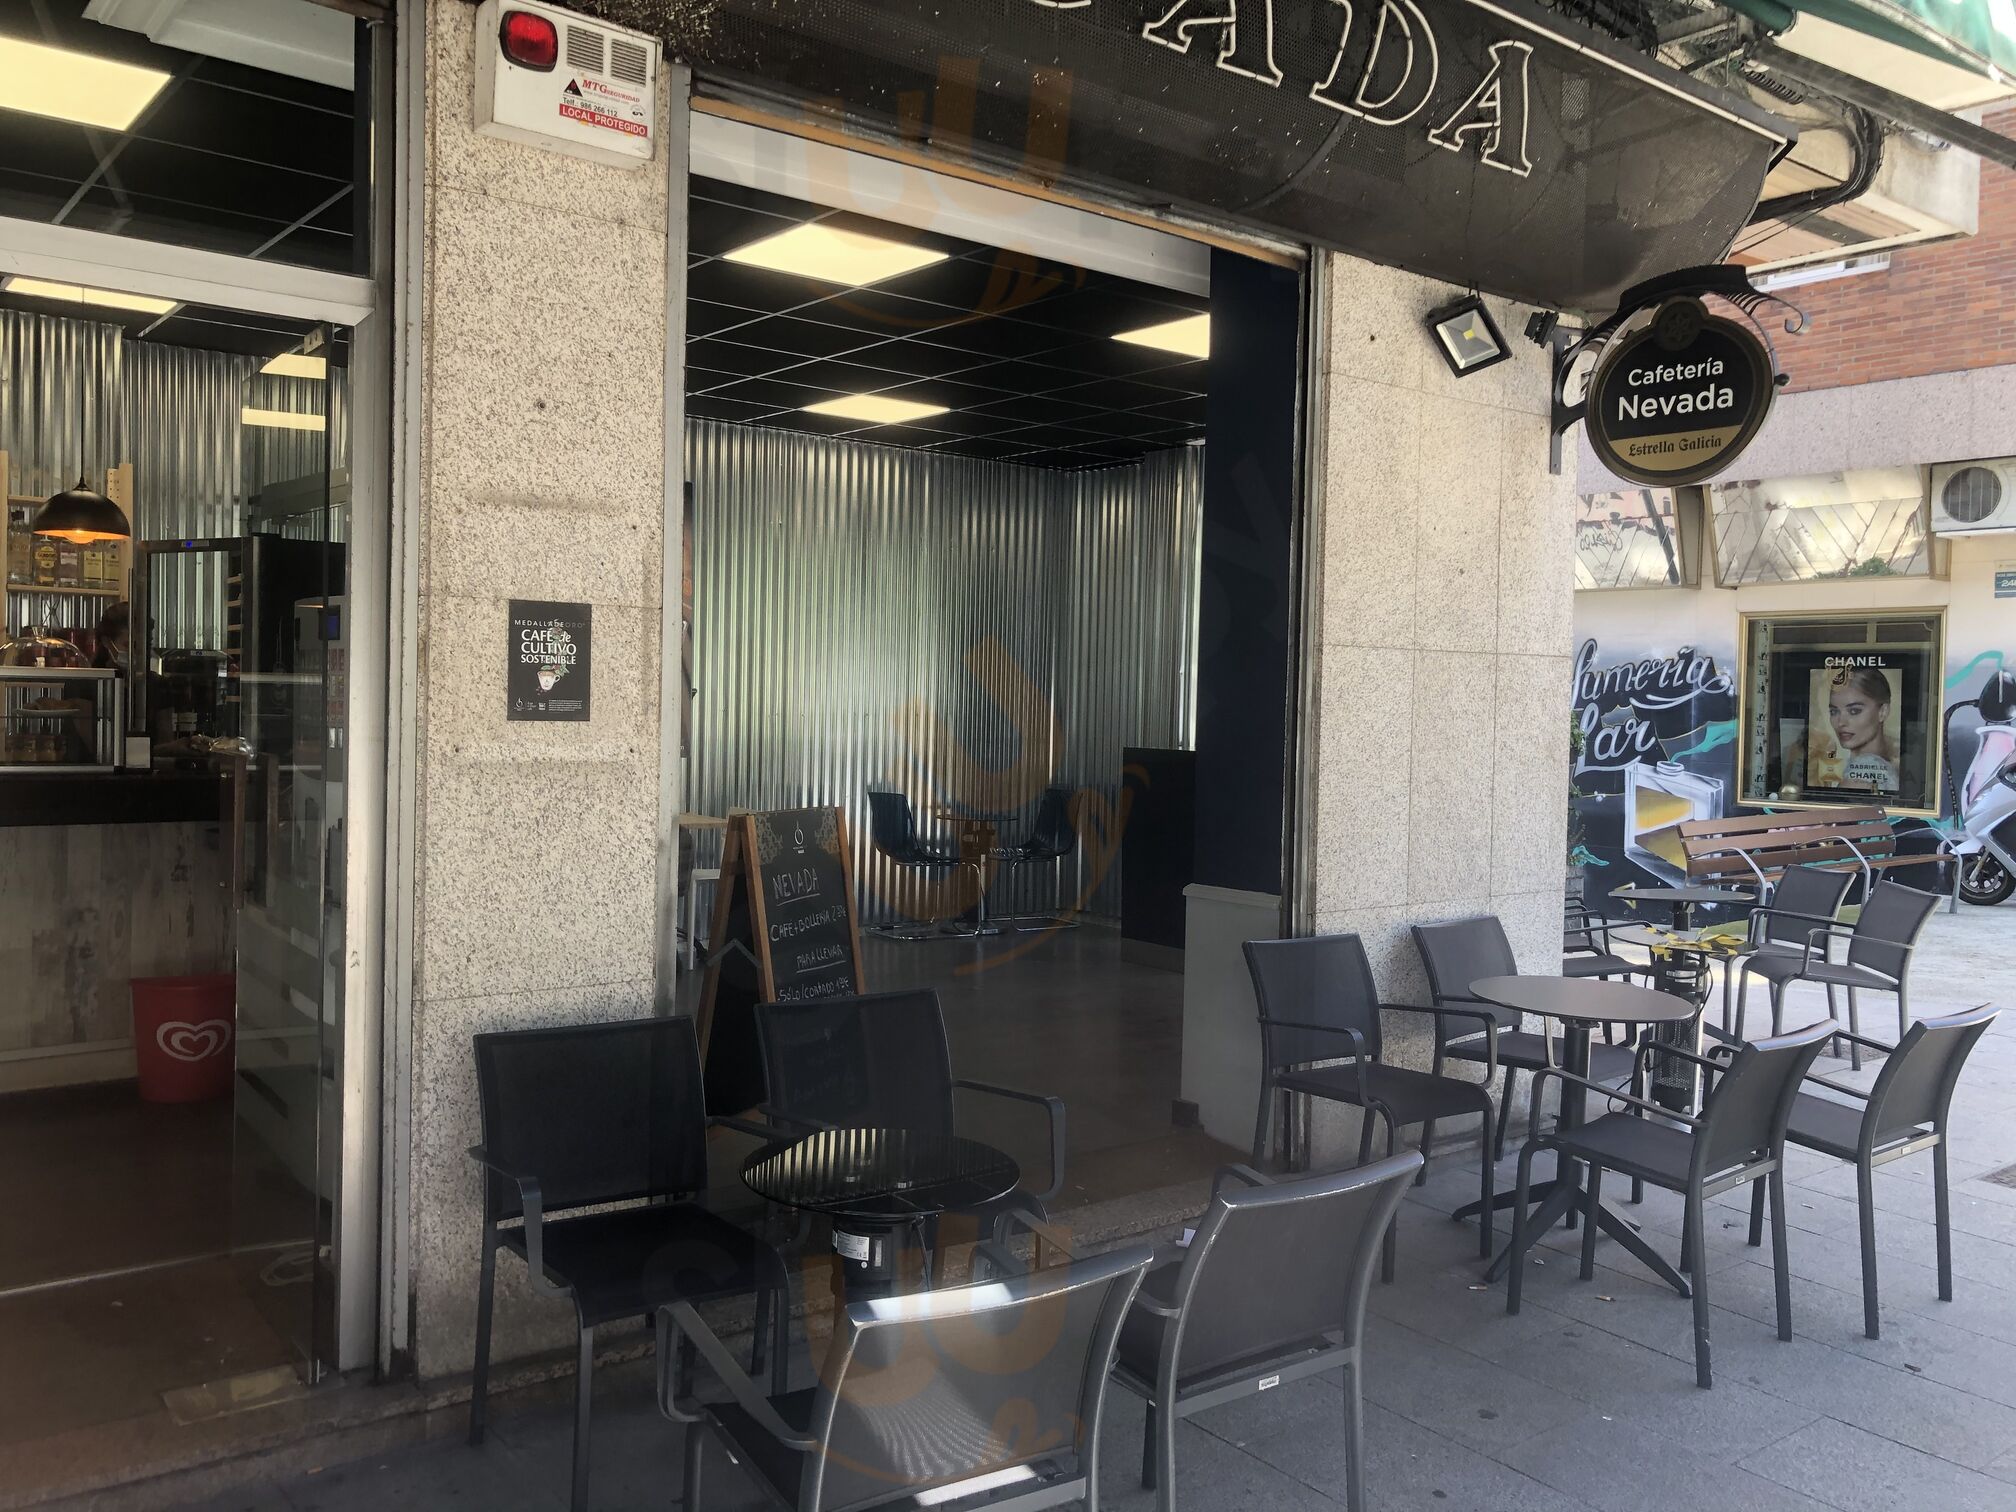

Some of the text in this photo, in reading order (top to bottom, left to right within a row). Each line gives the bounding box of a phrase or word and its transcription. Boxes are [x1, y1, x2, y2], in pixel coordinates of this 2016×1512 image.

[582, 79, 607, 94] MTG
[562, 106, 645, 136] LOCAL PROTEGIDO
[1628, 358, 1724, 386] Cafetería
[1618, 384, 1734, 421] Nevada
[1629, 436, 1722, 457] Estrella Galicia
[521, 627, 572, 643] CAFÉ de
[521, 642, 577, 655] CULTIVO
[520, 654, 577, 665] SOSTENIBLE
[1824, 656, 1887, 667] CHANEL
[1849, 771, 1888, 781] CHANEL
[771, 868, 820, 900] NEVADA
